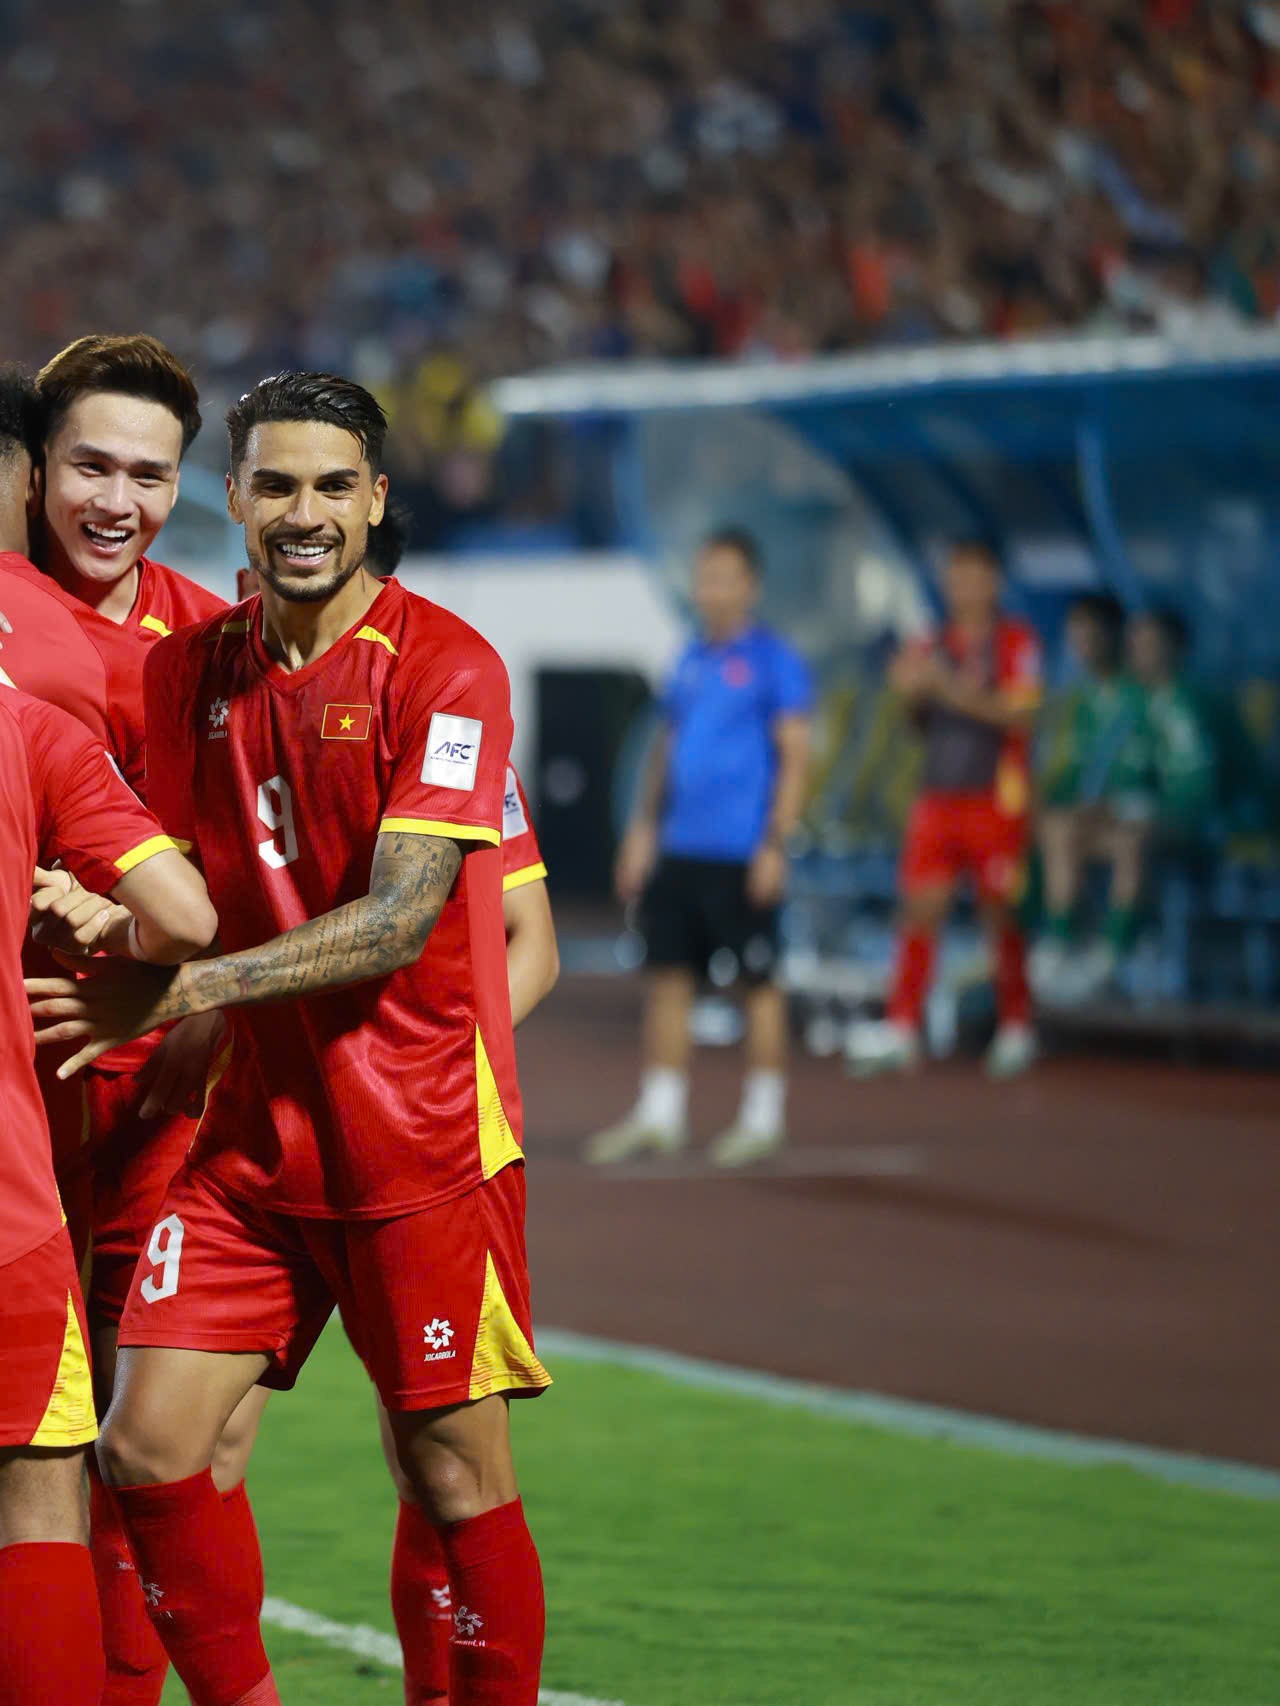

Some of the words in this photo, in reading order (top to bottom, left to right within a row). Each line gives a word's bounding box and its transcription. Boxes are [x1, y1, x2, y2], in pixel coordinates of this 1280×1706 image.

[434, 741, 472, 760] AFC
[257, 775, 299, 870] 9
[140, 1212, 185, 1305] 9
